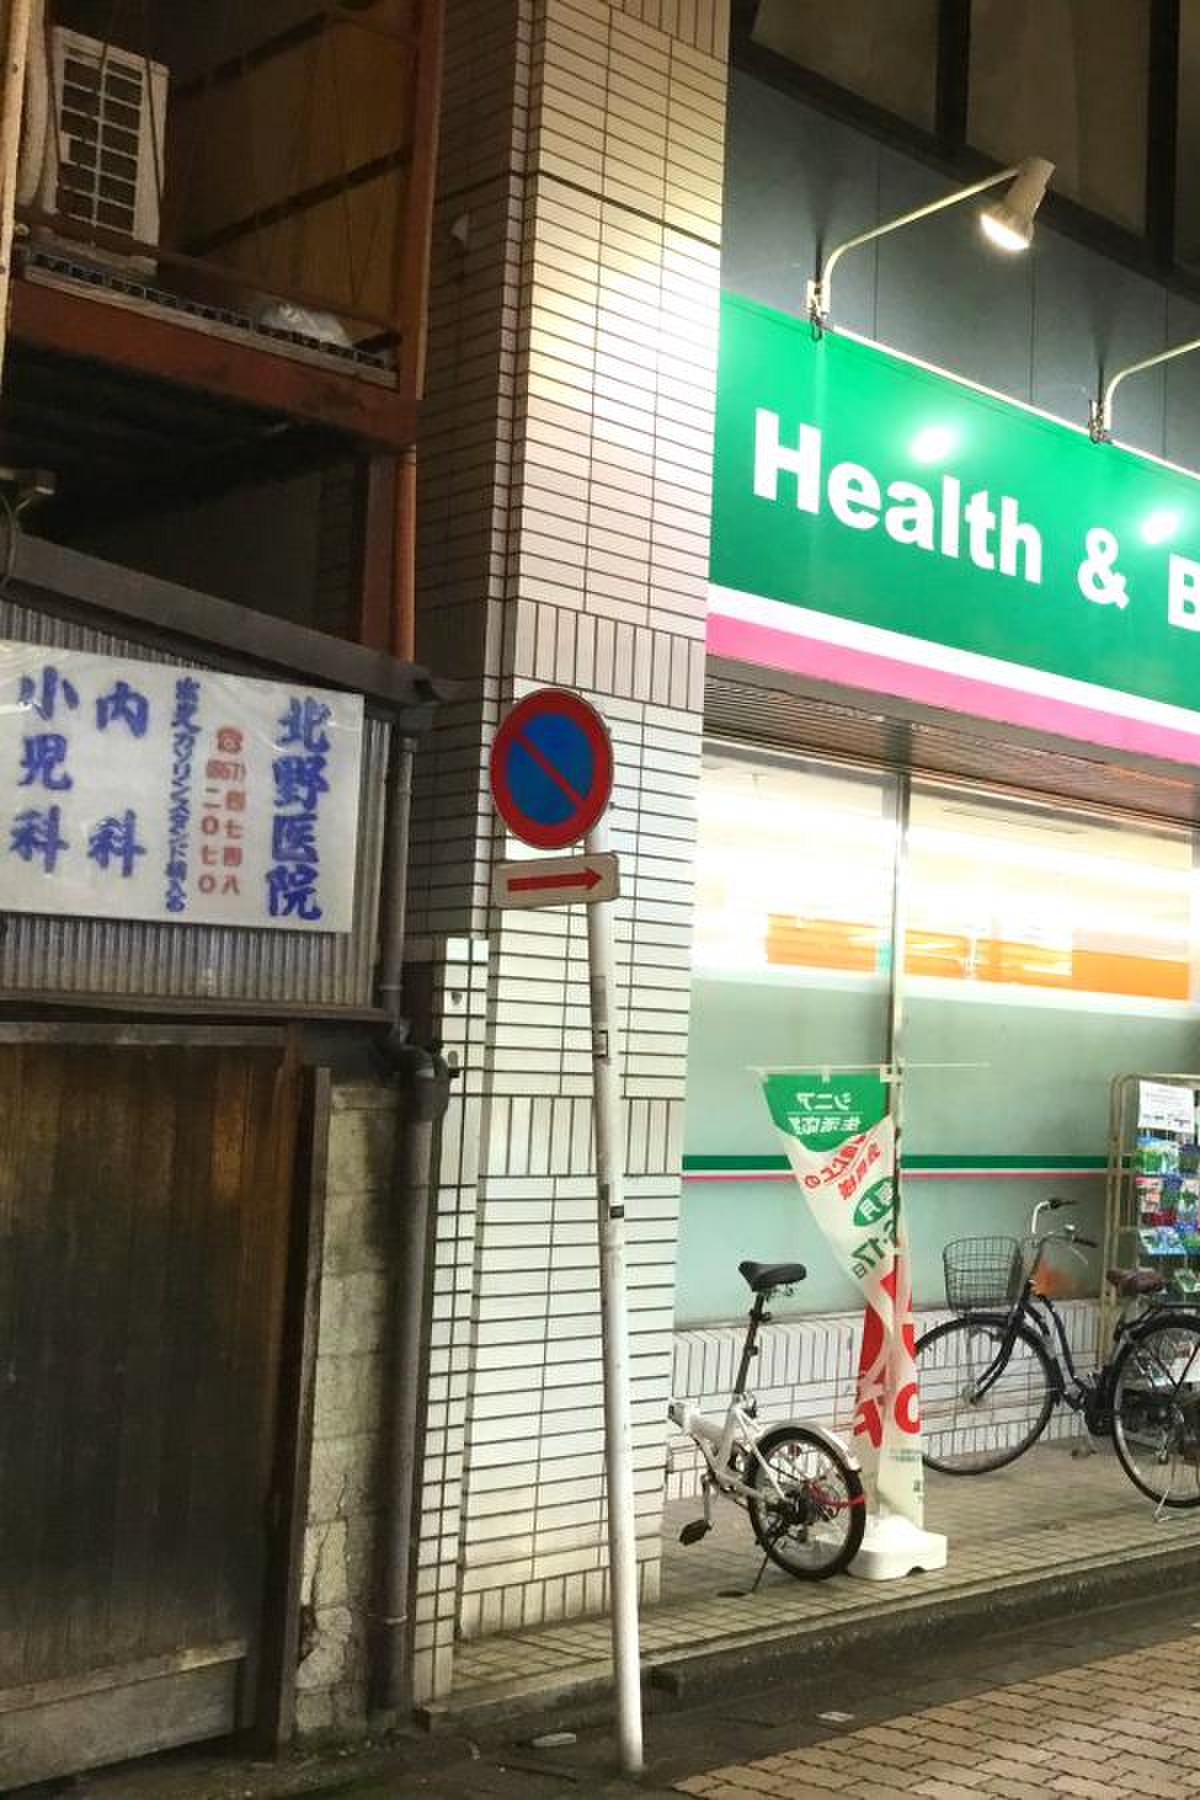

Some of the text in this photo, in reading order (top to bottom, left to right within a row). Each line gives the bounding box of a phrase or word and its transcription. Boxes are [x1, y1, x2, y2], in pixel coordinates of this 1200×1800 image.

[753, 407, 1042, 584] Health
[1078, 527, 1130, 609] &
[87, 680, 149, 878] 内科
